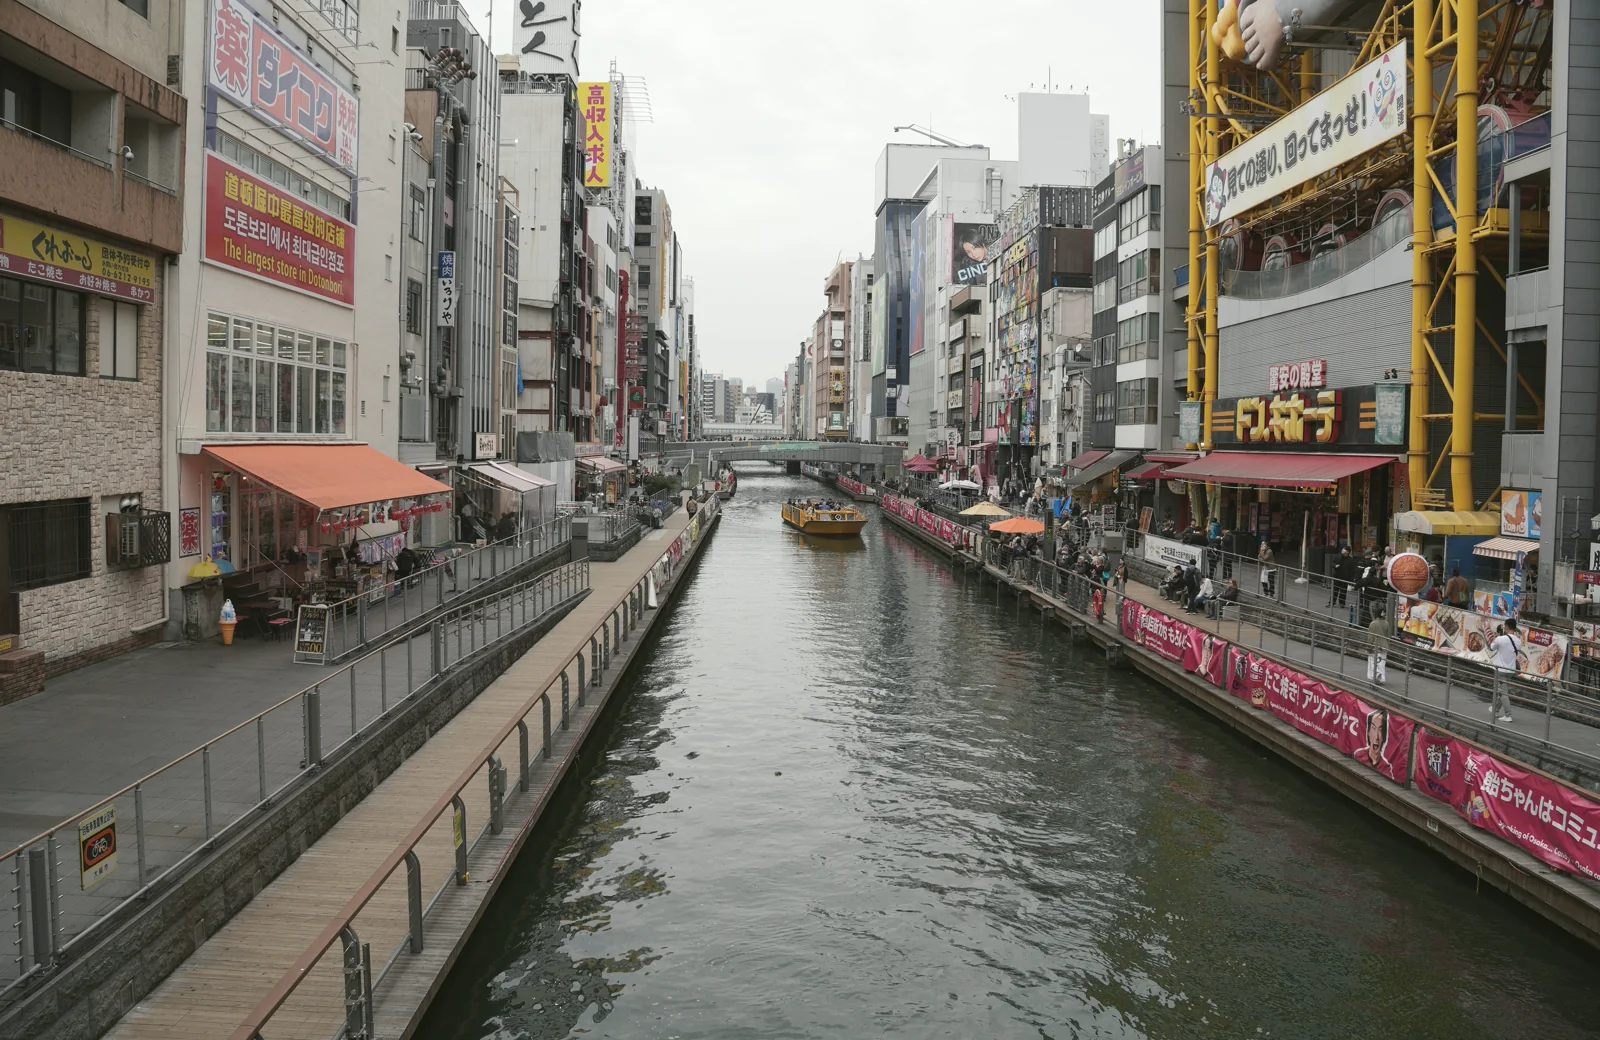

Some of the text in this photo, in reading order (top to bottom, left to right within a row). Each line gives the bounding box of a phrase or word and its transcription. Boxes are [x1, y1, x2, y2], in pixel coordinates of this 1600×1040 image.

[216, 0, 249, 91] 薬
[257, 40, 334, 145] ダイコク
[338, 92, 357, 138] 免税
[342, 131, 352, 151] TAX
[585, 85, 606, 183] 高収入求人
[339, 149, 353, 166] FREE
[223, 206, 345, 274] 도톤보리에서 최대급인점포
[28, 261, 64, 281] たこ焼き
[79, 274, 117, 294] お好み焼き
[130, 286, 151, 300] 串かつ
[101, 267, 150, 287] 06-6212-9195
[223, 237, 344, 296] The largest store in Dotonbori.
[442, 254, 453, 325] 焼肉 いろりや
[1269, 359, 1325, 392] 驚安の殿堂
[1378, 390, 1402, 417] 薬
[182, 511, 199, 553] 薬
[1302, 688, 1359, 737] アツアツやで
[1481, 769, 1600, 850] 飴ちゃんはコミュ
[1522, 832, 1530, 841] of
[1575, 860, 1593, 877] Osaka
